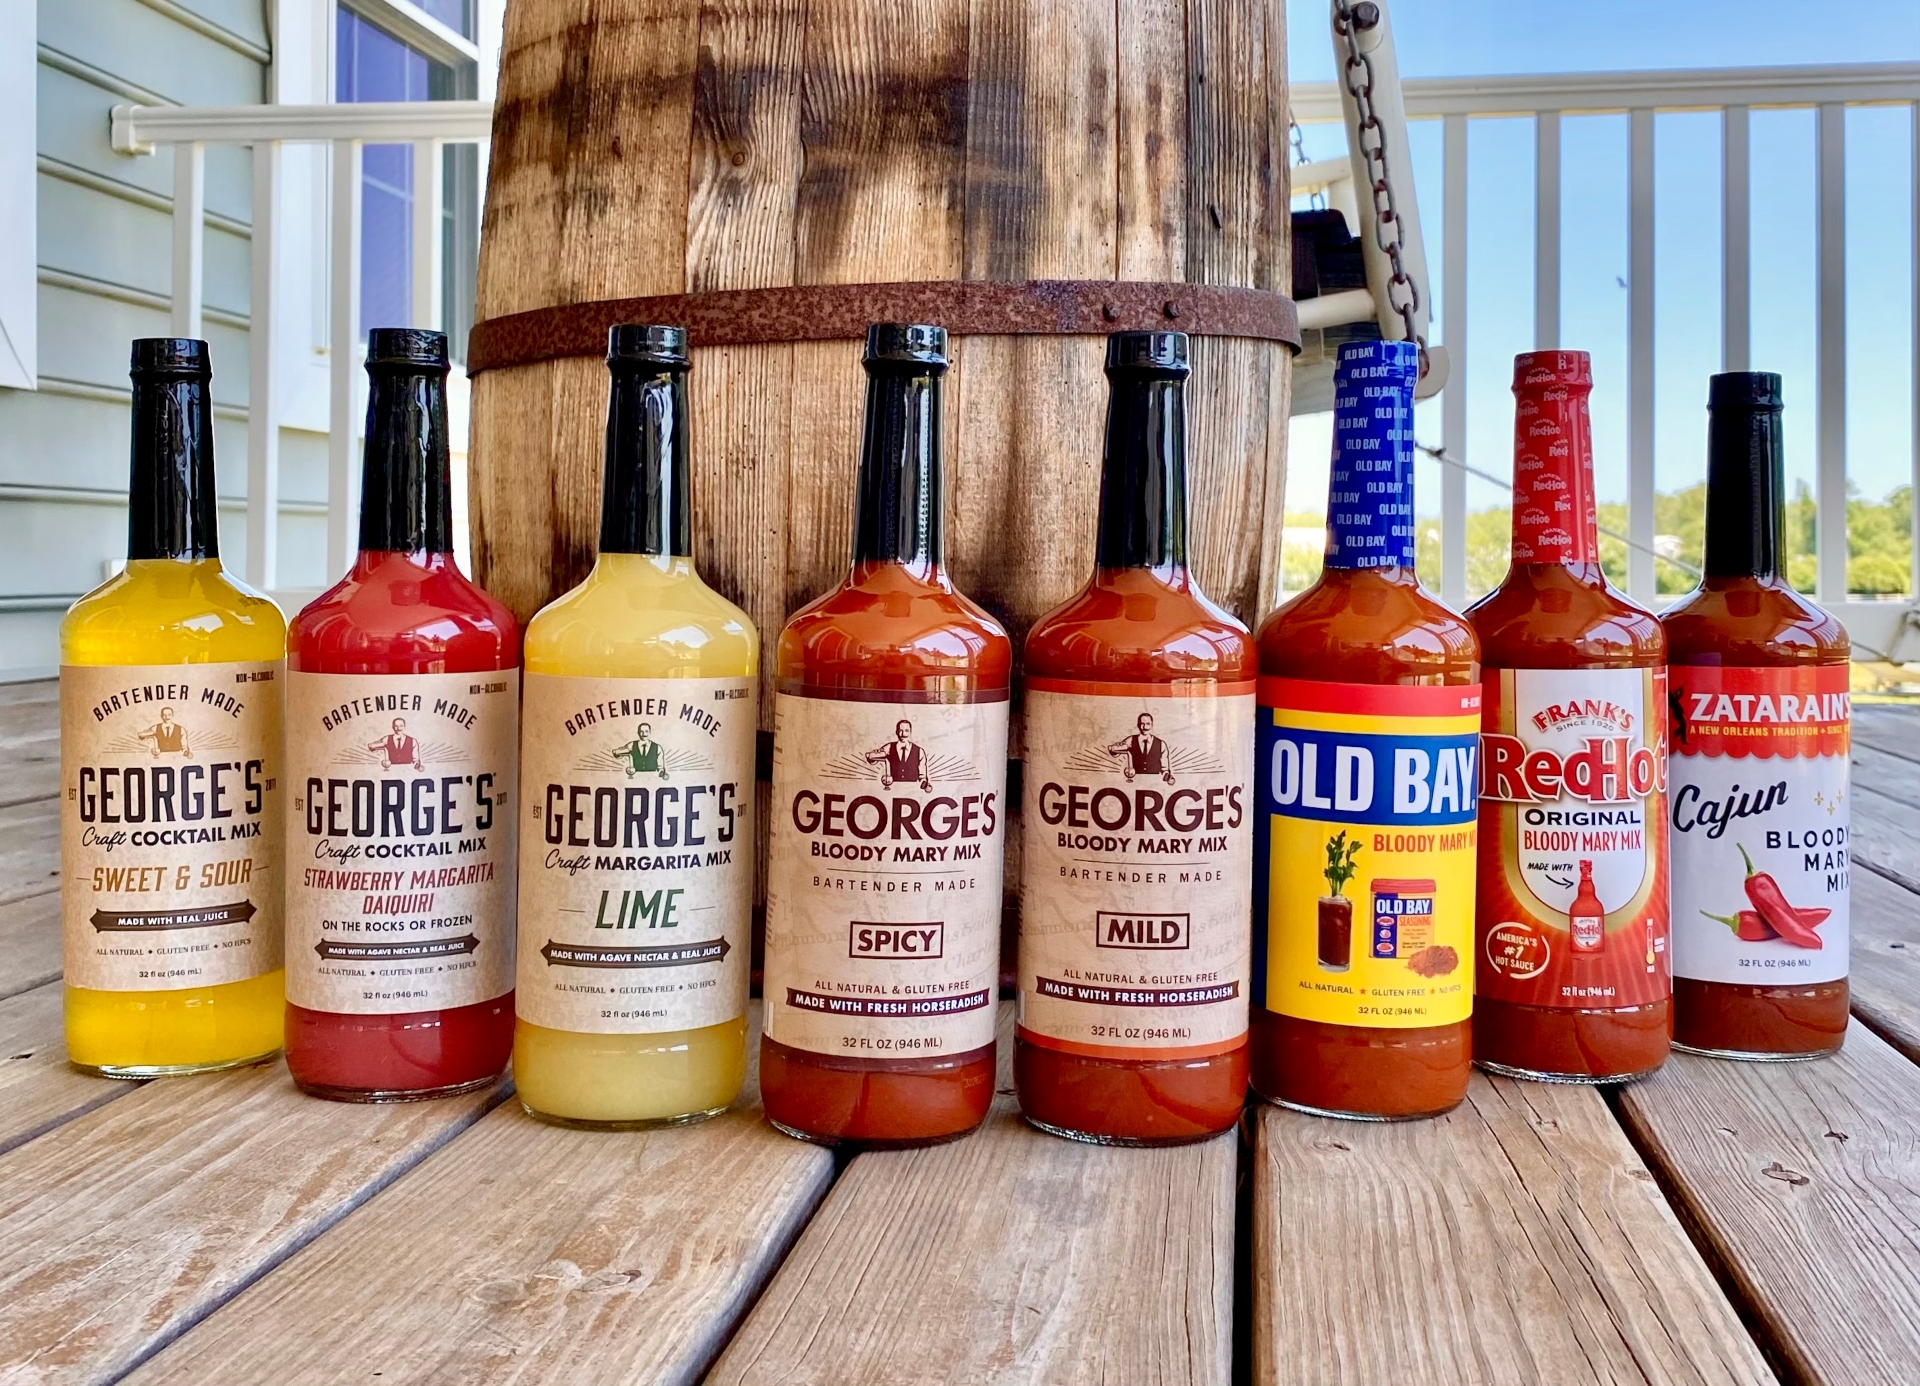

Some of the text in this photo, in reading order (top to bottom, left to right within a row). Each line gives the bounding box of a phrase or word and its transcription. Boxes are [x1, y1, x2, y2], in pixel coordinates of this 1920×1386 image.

[1351, 368, 1368, 377] OLD
[1525, 373, 1556, 384] RedHot
[1339, 418, 1368, 429] OLD BAY
[1529, 426, 1561, 436] RedHot
[1346, 439, 1380, 449] OLD BAY
[1356, 460, 1392, 471] OLD BAY
[1367, 482, 1403, 493] OLD BAY
[1533, 480, 1567, 490] RedHot
[1380, 504, 1411, 515] OLD BAY
[1337, 514, 1372, 525] OLD BAY
[1346, 536, 1385, 546] OLD BAY
[1538, 534, 1572, 546] RedHot
[1358, 556, 1397, 567] OLD BAY
[93, 684, 244, 722] BARTENDER MADE
[322, 694, 477, 731] BARTENDER MADE
[565, 699, 722, 737] BARTENDER MADE
[1532, 699, 1634, 732] FRANK'S
[1556, 720, 1614, 732] SINCE 1920
[1690, 726, 1695, 734] A
[1699, 726, 1719, 735] NEW
[1723, 727, 1768, 736] ORLEANS
[1772, 727, 1818, 736] TRADITION
[1271, 738, 1374, 812] OLD
[1480, 733, 1668, 802] RedHot
[79, 760, 261, 823] GEORGE'S
[307, 773, 492, 838] GEORGE'S
[1039, 782, 1243, 832] GEORGE'S
[1672, 781, 1788, 839] Cajun
[545, 782, 734, 848] GEORGE'S
[792, 789, 996, 840] GEORGE'S
[1524, 808, 1641, 826] ORIGINAL
[82, 822, 261, 852] Craft COCKTAIL MIX
[1058, 832, 1228, 854] BLOODY MARY MIX
[1374, 831, 1469, 853] BLOODY MARY
[1524, 829, 1641, 852] BLOODY MARY MIX
[1766, 825, 1850, 849] BLOODY
[315, 837, 487, 865] Craft COCKTAIL MIX
[811, 841, 981, 862] BLOODY MARY MIX
[545, 849, 731, 876] Craft MARGARITA MIX
[1527, 862, 1573, 872] MADE WITH
[1804, 851, 1850, 871] MARY
[92, 858, 252, 892] SWEET & SOUR
[304, 861, 494, 891] STRAWBERRY MARGARITA
[1060, 866, 1222, 883] BARTENDER MADE
[1827, 873, 1850, 893] MIX
[813, 876, 975, 892] BARTENDER MADE
[362, 893, 435, 916] DAIQUIRI
[595, 889, 684, 929] LIME
[1376, 899, 1403, 914] OLD
[117, 911, 228, 926] MADE WITH REAL JUICE
[322, 914, 473, 932] ON THE ROCKS OR FROZEN
[1399, 916, 1431, 926] SEASONING
[1107, 919, 1180, 944] MILD
[1496, 931, 1537, 946] AMERICA'S
[857, 929, 937, 952] SPICY
[550, 950, 572, 959] MADE
[574, 952, 597, 961] WITH
[600, 953, 631, 962] AGAVE
[634, 952, 669, 961] NECTAR
[681, 950, 701, 959] REAL
[702, 946, 721, 956] JUICE
[1504, 945, 1524, 959] #1
[1495, 955, 1534, 971] HOT SAUCE
[1739, 959, 1750, 967] 32
[1778, 959, 1796, 968] (946
[1798, 958, 1811, 967] ML)
[1063, 969, 1218, 984] ALL NATURAL & GLUTEN FREE
[555, 983, 567, 991] ALL
[569, 985, 606, 994] NATURAL
[620, 986, 653, 994] GLUTEN
[815, 980, 970, 995] ALL NATURAL & GLUTEN FREE
[1045, 982, 1234, 1003] MADE WITH FRESH HORSERADISH
[1299, 981, 1313, 989] ALL
[1315, 983, 1354, 994] NATURAL
[795, 993, 984, 1013] MADE WITH FRESH HORSERADISH
[1091, 1025, 1191, 1039] 32 FL OZ (946 ML)
[842, 1037, 943, 1050] 32 FL OZ (946 ML)
